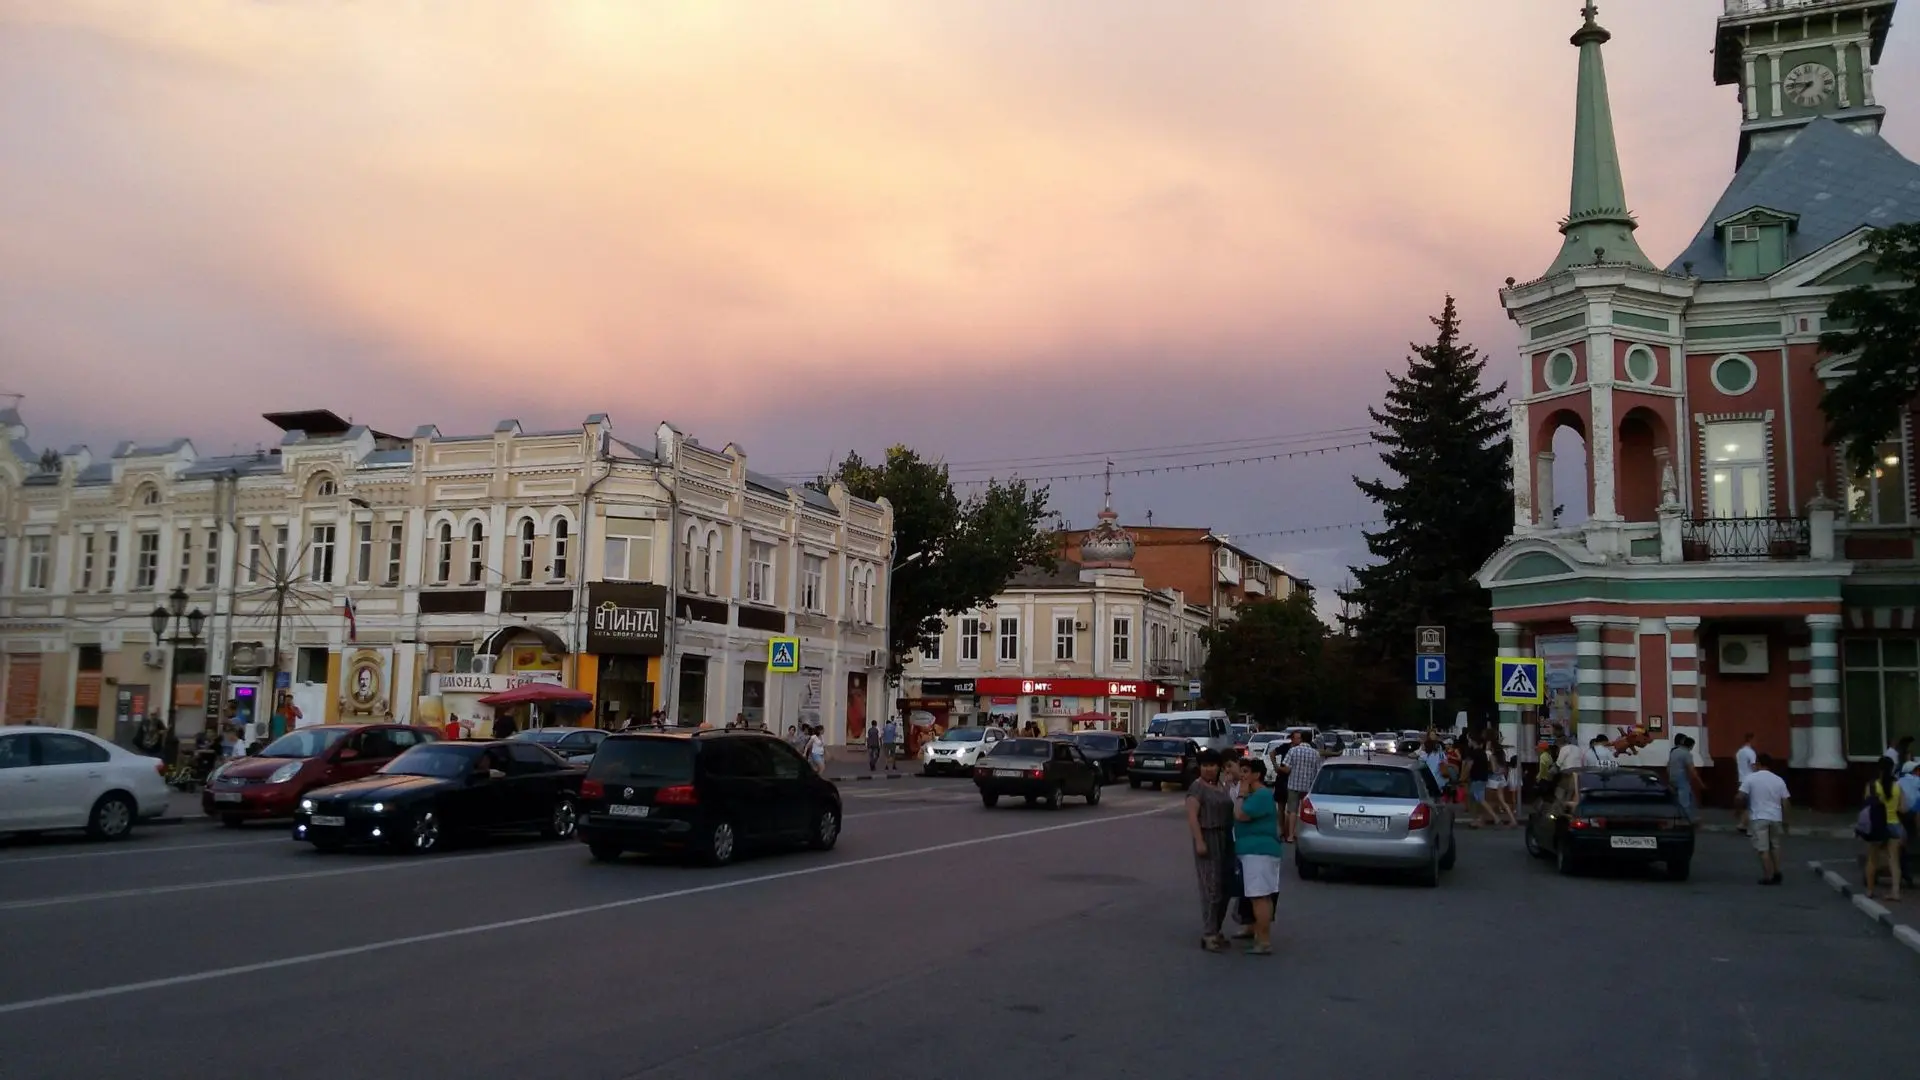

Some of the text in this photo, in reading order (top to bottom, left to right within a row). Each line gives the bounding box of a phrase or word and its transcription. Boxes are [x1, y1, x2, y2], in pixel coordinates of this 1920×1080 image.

[1424, 658, 1441, 680] P
[954, 682, 974, 692] TELE2
[1034, 682, 1053, 691] МТС
[1120, 684, 1137, 693] МТС
